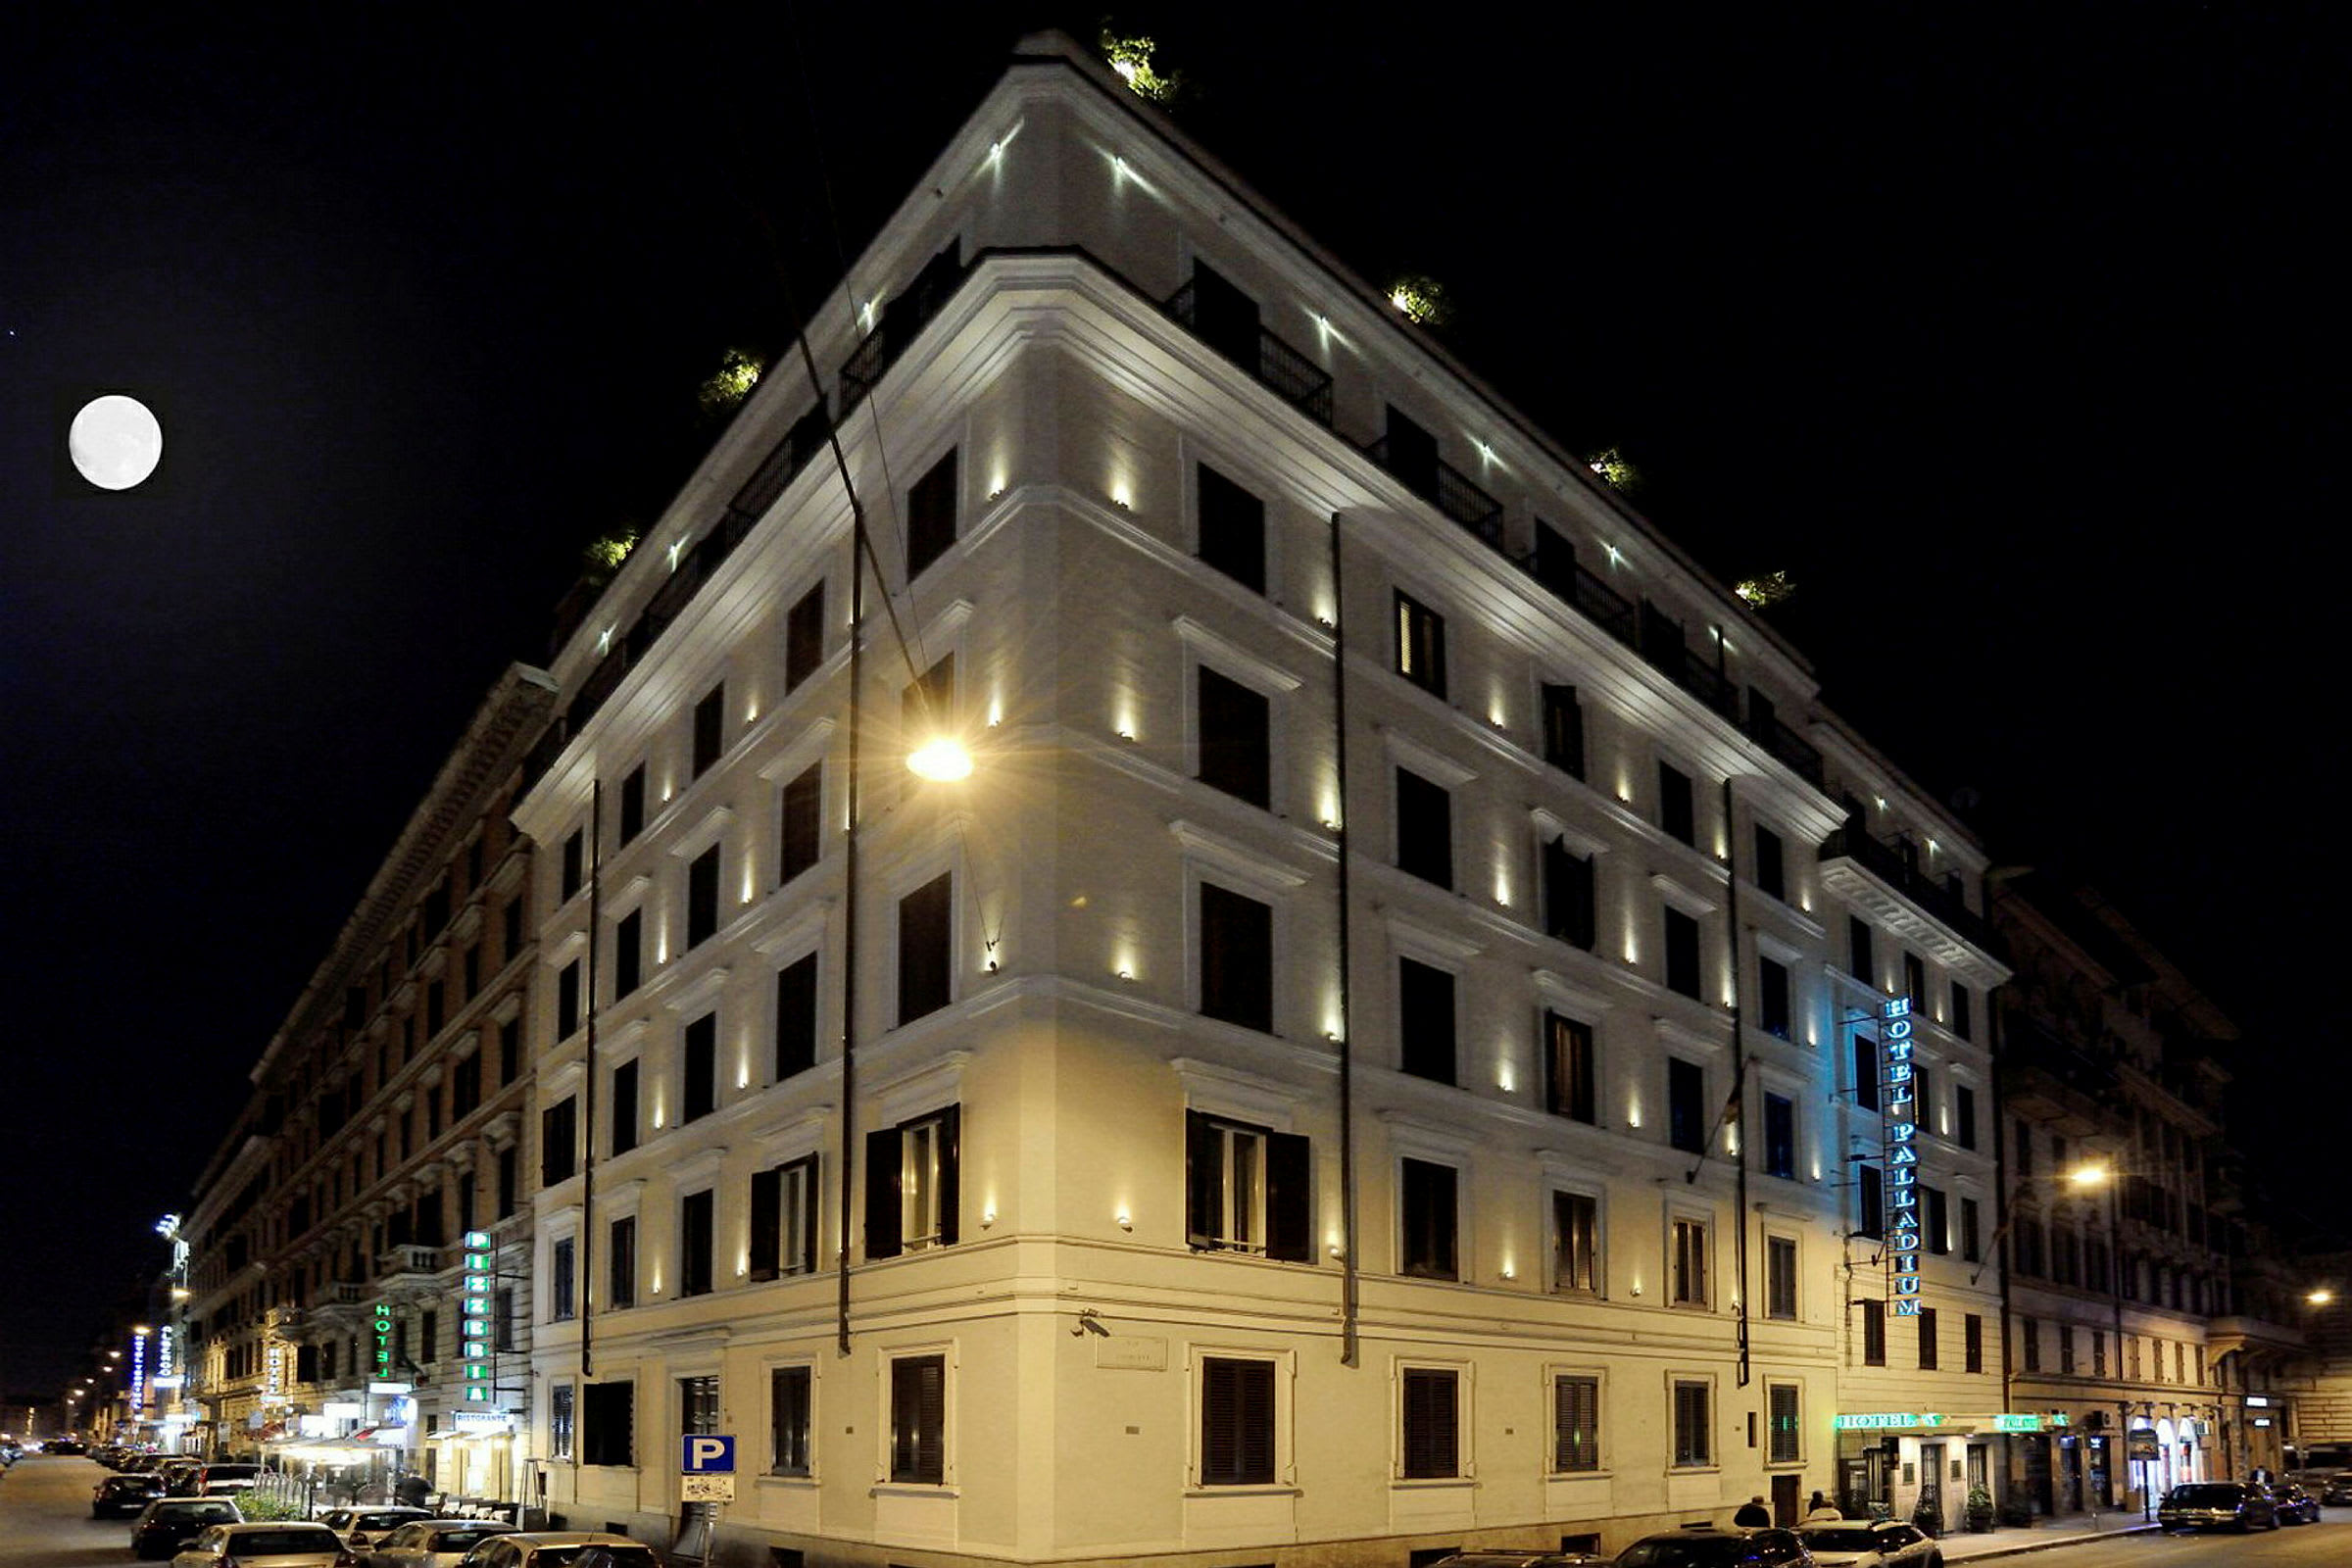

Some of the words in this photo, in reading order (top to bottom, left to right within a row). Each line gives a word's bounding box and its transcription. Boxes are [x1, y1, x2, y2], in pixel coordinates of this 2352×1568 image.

[1885, 998, 1912, 1104] HOTEL
[1892, 1123, 1923, 1315] PALLADIUM
[466, 1232, 490, 1401] PIZZERIA
[269, 1348, 281, 1395] HOTEL
[693, 1438, 724, 1469] P
[1840, 1414, 1913, 1427] HOTEL
